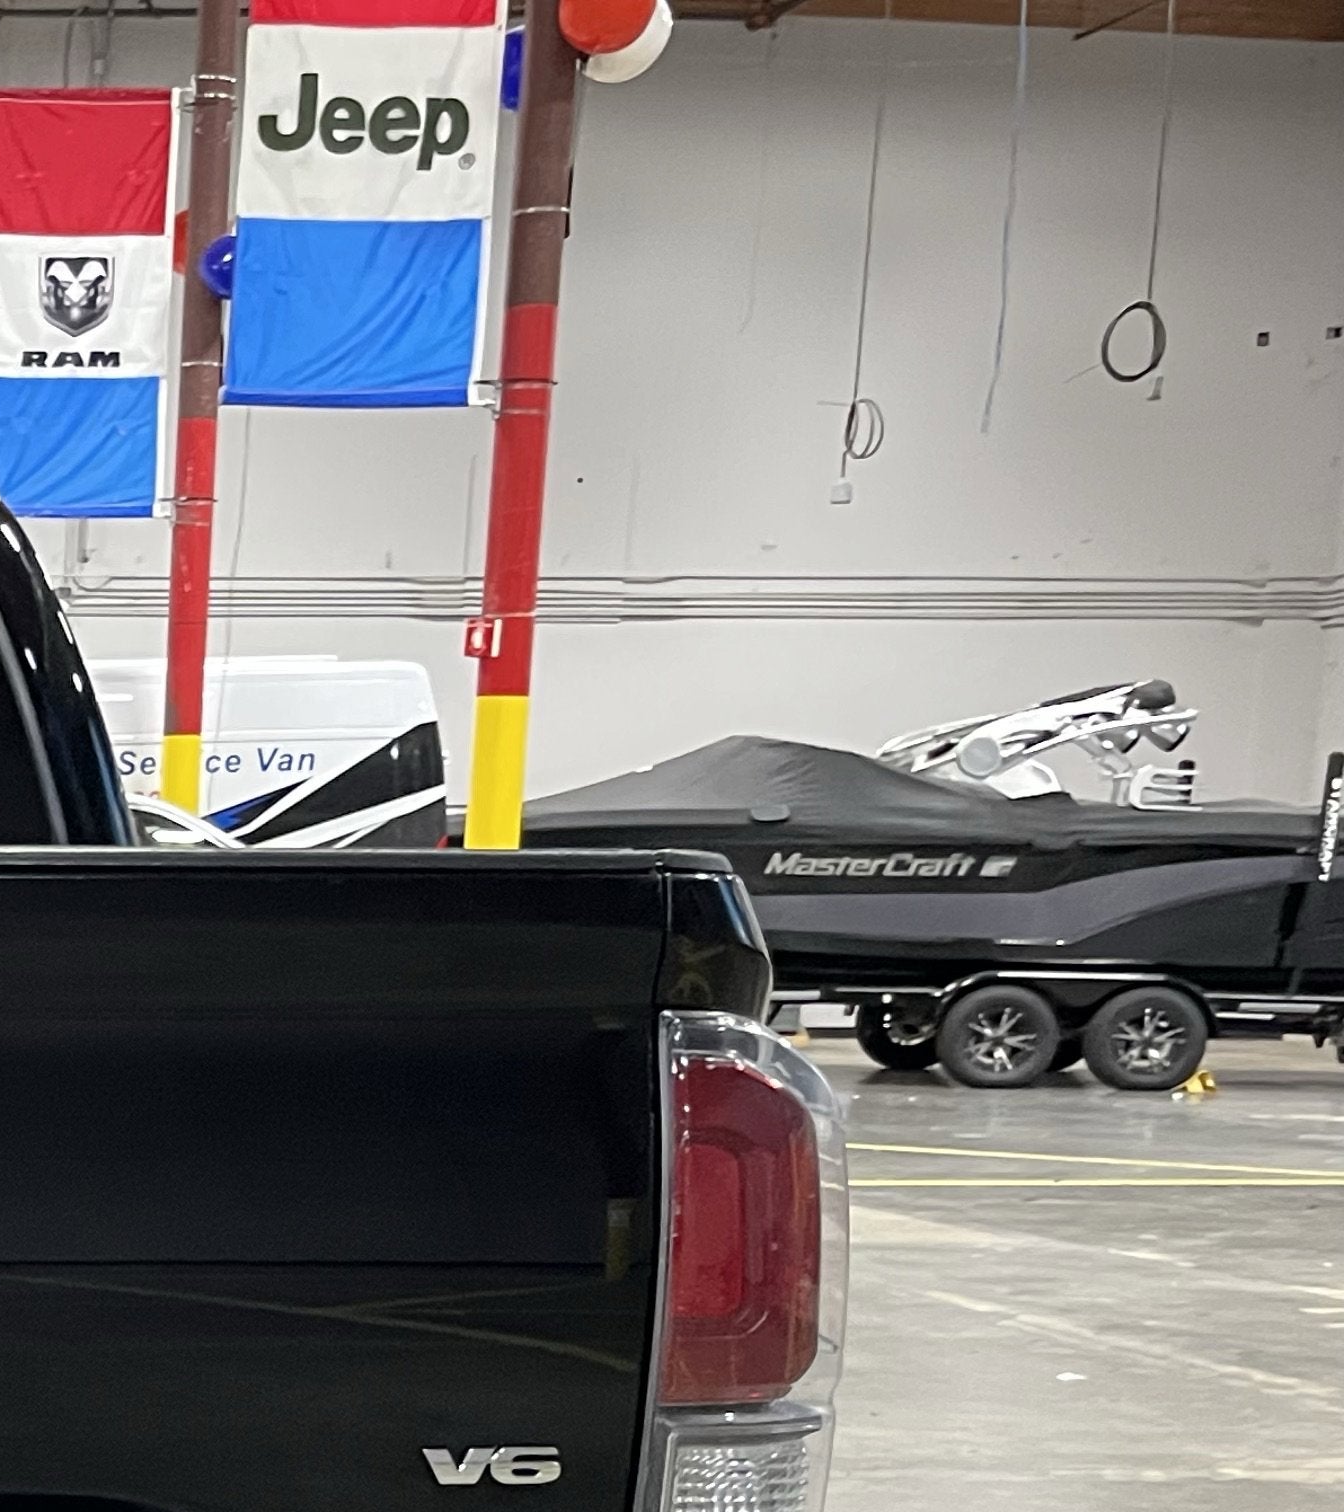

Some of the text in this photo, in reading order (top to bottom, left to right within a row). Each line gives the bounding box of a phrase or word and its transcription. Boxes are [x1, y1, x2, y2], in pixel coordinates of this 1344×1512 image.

[257, 73, 471, 171] Jeep
[21, 351, 120, 368] RAM
[257, 747, 316, 772] Van
[763, 852, 976, 877] MasterCraft
[422, 1446, 561, 1485] V6
